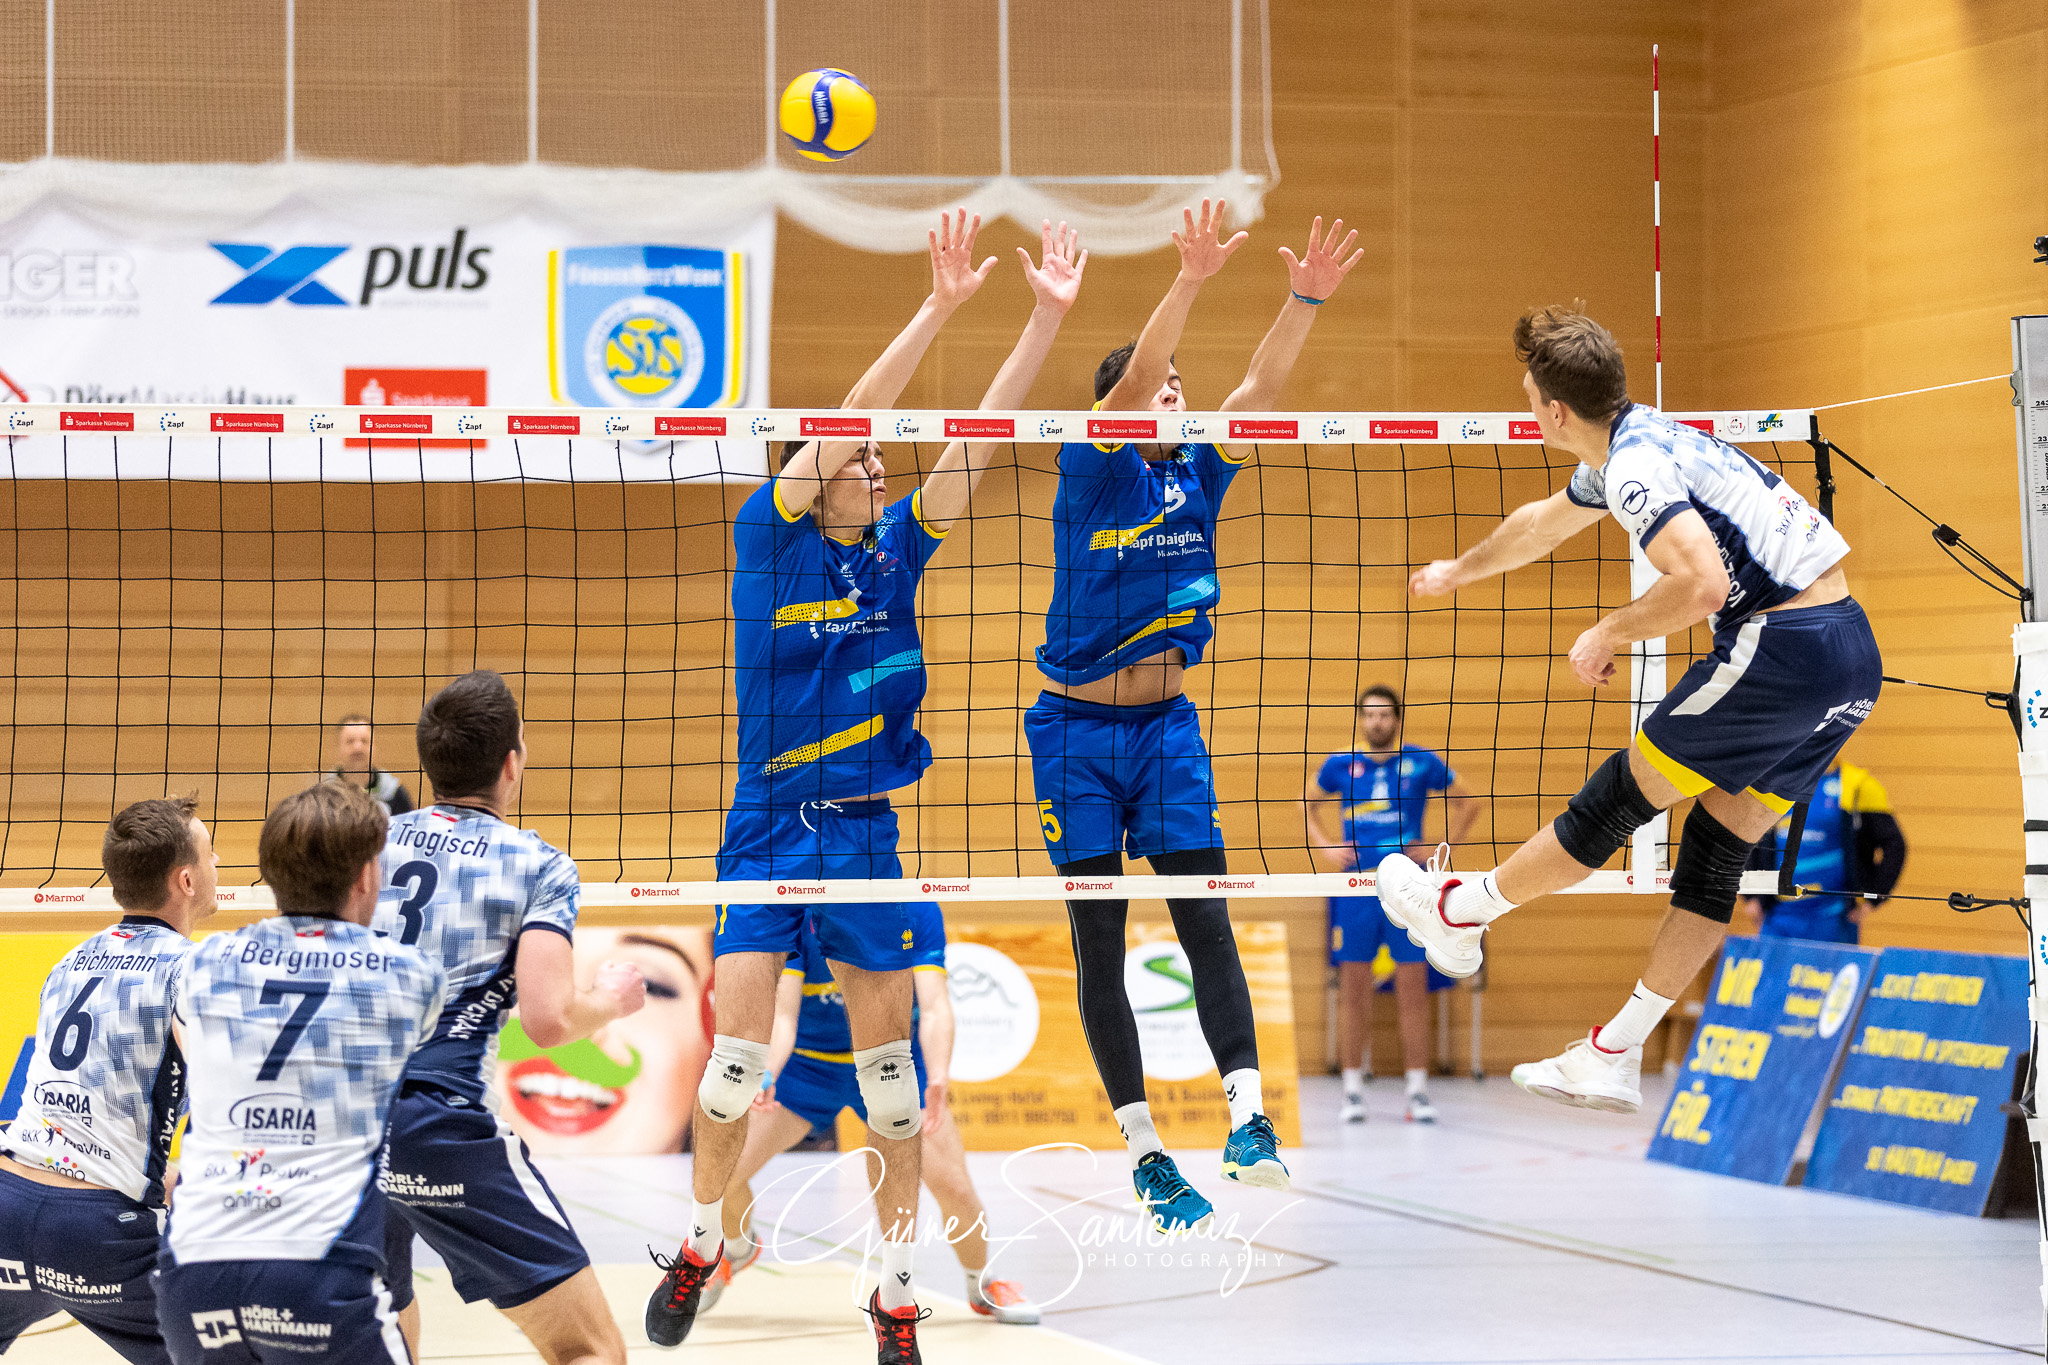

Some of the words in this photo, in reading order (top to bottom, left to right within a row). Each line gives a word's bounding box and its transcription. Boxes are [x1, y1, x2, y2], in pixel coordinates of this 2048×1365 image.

[361, 227, 492, 306] puls
[16, 419, 34, 428] Zapf
[75, 420, 102, 429] Sparkasse
[103, 421, 129, 430] Nürnberg
[167, 420, 185, 429] Zapf
[225, 420, 252, 429] Sparkasse
[253, 421, 279, 430] Nürnberg
[316, 421, 334, 430] Zapf
[374, 421, 401, 430] Sparkasse
[402, 422, 428, 431] Nürnberg
[465, 422, 482, 432] Zapf
[522, 423, 550, 432] Sparkasse
[550, 423, 576, 432] Nürnberg
[612, 424, 630, 433] Zapf
[669, 424, 696, 433] Sparkasse
[696, 424, 722, 433] Nürnberg
[1757, 420, 1783, 429] HUCK
[758, 424, 775, 434] Zapf
[815, 425, 841, 434] Sparkasse
[842, 425, 867, 433] Nürnberg
[902, 425, 920, 434] Zapf
[959, 426, 985, 435] Sparkasse
[985, 426, 1010, 434] Nürnberg
[1046, 427, 1063, 436] Zapf
[1102, 427, 1128, 436] Sparkasse
[1128, 427, 1153, 436] Nürnberg
[1188, 427, 1205, 436] Zapf
[1243, 427, 1268, 436] Sparkasse
[1269, 427, 1294, 436] Nürnberg
[1329, 428, 1345, 436] Zapf
[1383, 428, 1408, 436] Sparkasse
[1409, 428, 1434, 436] Nürnberg
[1468, 428, 1485, 436] Zapf
[1129, 535, 1154, 550] apf
[1038, 799, 1062, 842] 5
[397, 824, 489, 858] Trogisch
[1075, 881, 1114, 891] Marmot
[1218, 880, 1256, 889] Marmot
[1358, 877, 1376, 887] Mar
[641, 887, 680, 897] Marmot
[788, 885, 826, 895] Marmot
[932, 883, 970, 893] Marmot
[45, 892, 86, 903] Marmot
[216, 892, 236, 903] mot
[390, 860, 440, 946] 3
[69, 949, 158, 974] Teichmann
[241, 940, 395, 974] Bergmoser
[1716, 956, 1764, 1008] WIR
[49, 976, 105, 1072] 6
[256, 978, 331, 1082] 7
[1689, 1023, 1773, 1082] STEHEN
[245, 1107, 317, 1131] ISARIA
[22, 1129, 42, 1143] BKK
[387, 1171, 427, 1186] ÖRL+
[389, 1183, 464, 1197] ARTMANN
[35, 1264, 86, 1286] HÖRL+
[36, 1274, 122, 1296] HARTMANN
[239, 1304, 294, 1321] HÖRL+
[241, 1316, 332, 1338] HARTMANN
